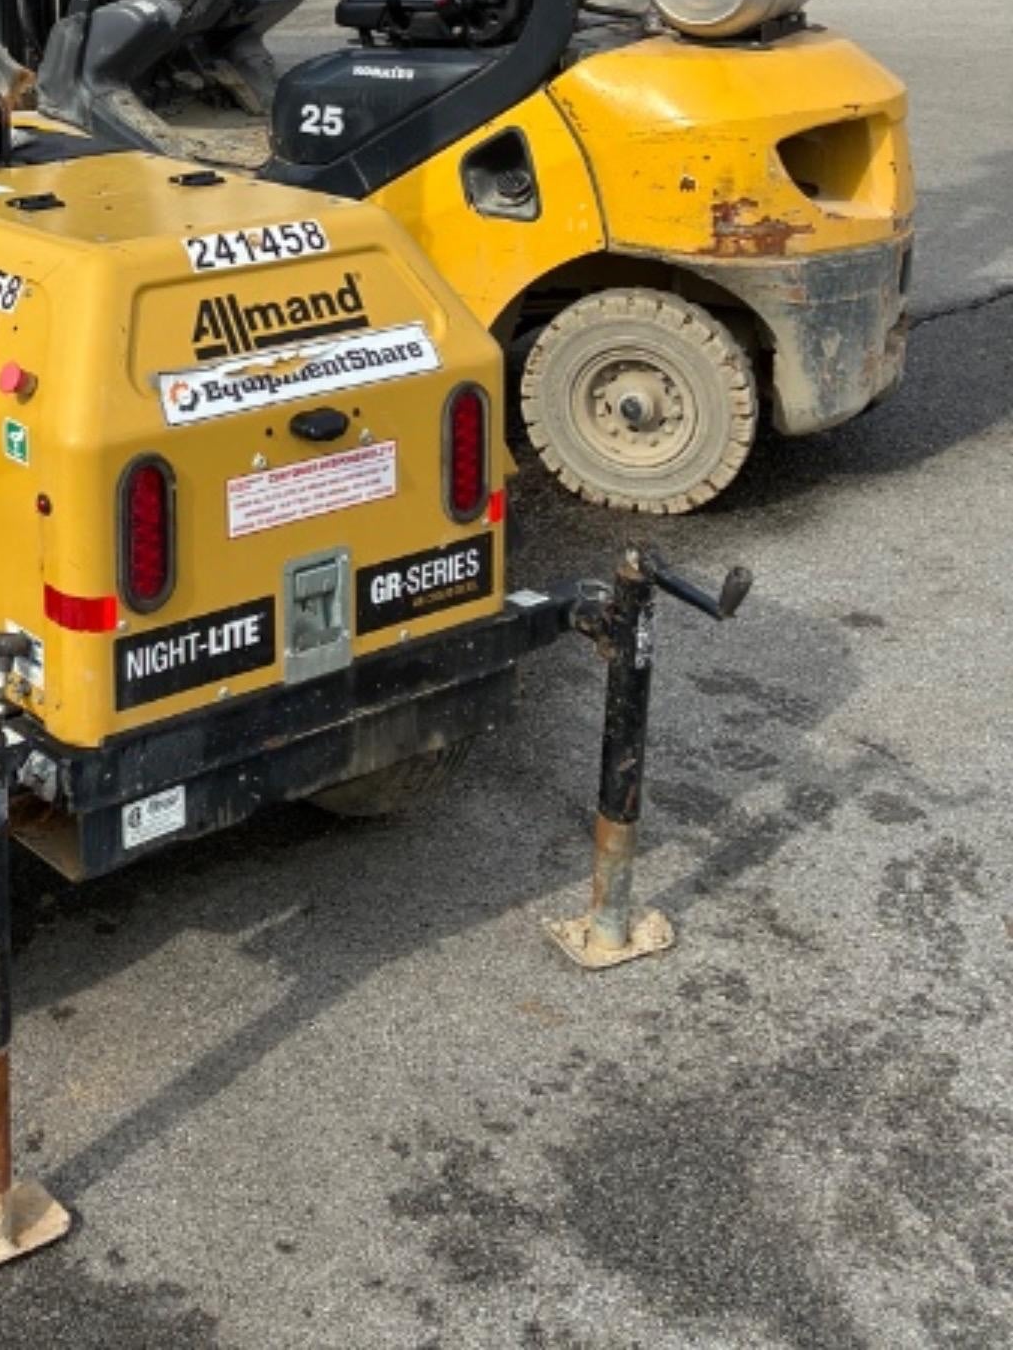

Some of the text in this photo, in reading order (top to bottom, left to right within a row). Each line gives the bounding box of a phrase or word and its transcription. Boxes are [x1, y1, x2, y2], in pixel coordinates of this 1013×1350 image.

[299, 103, 345, 136] 25
[187, 220, 326, 271] 241458
[192, 272, 365, 354] Allmand
[370, 547, 481, 605] GR-SERIES
[126, 614, 261, 682] NIGHT-LITE
